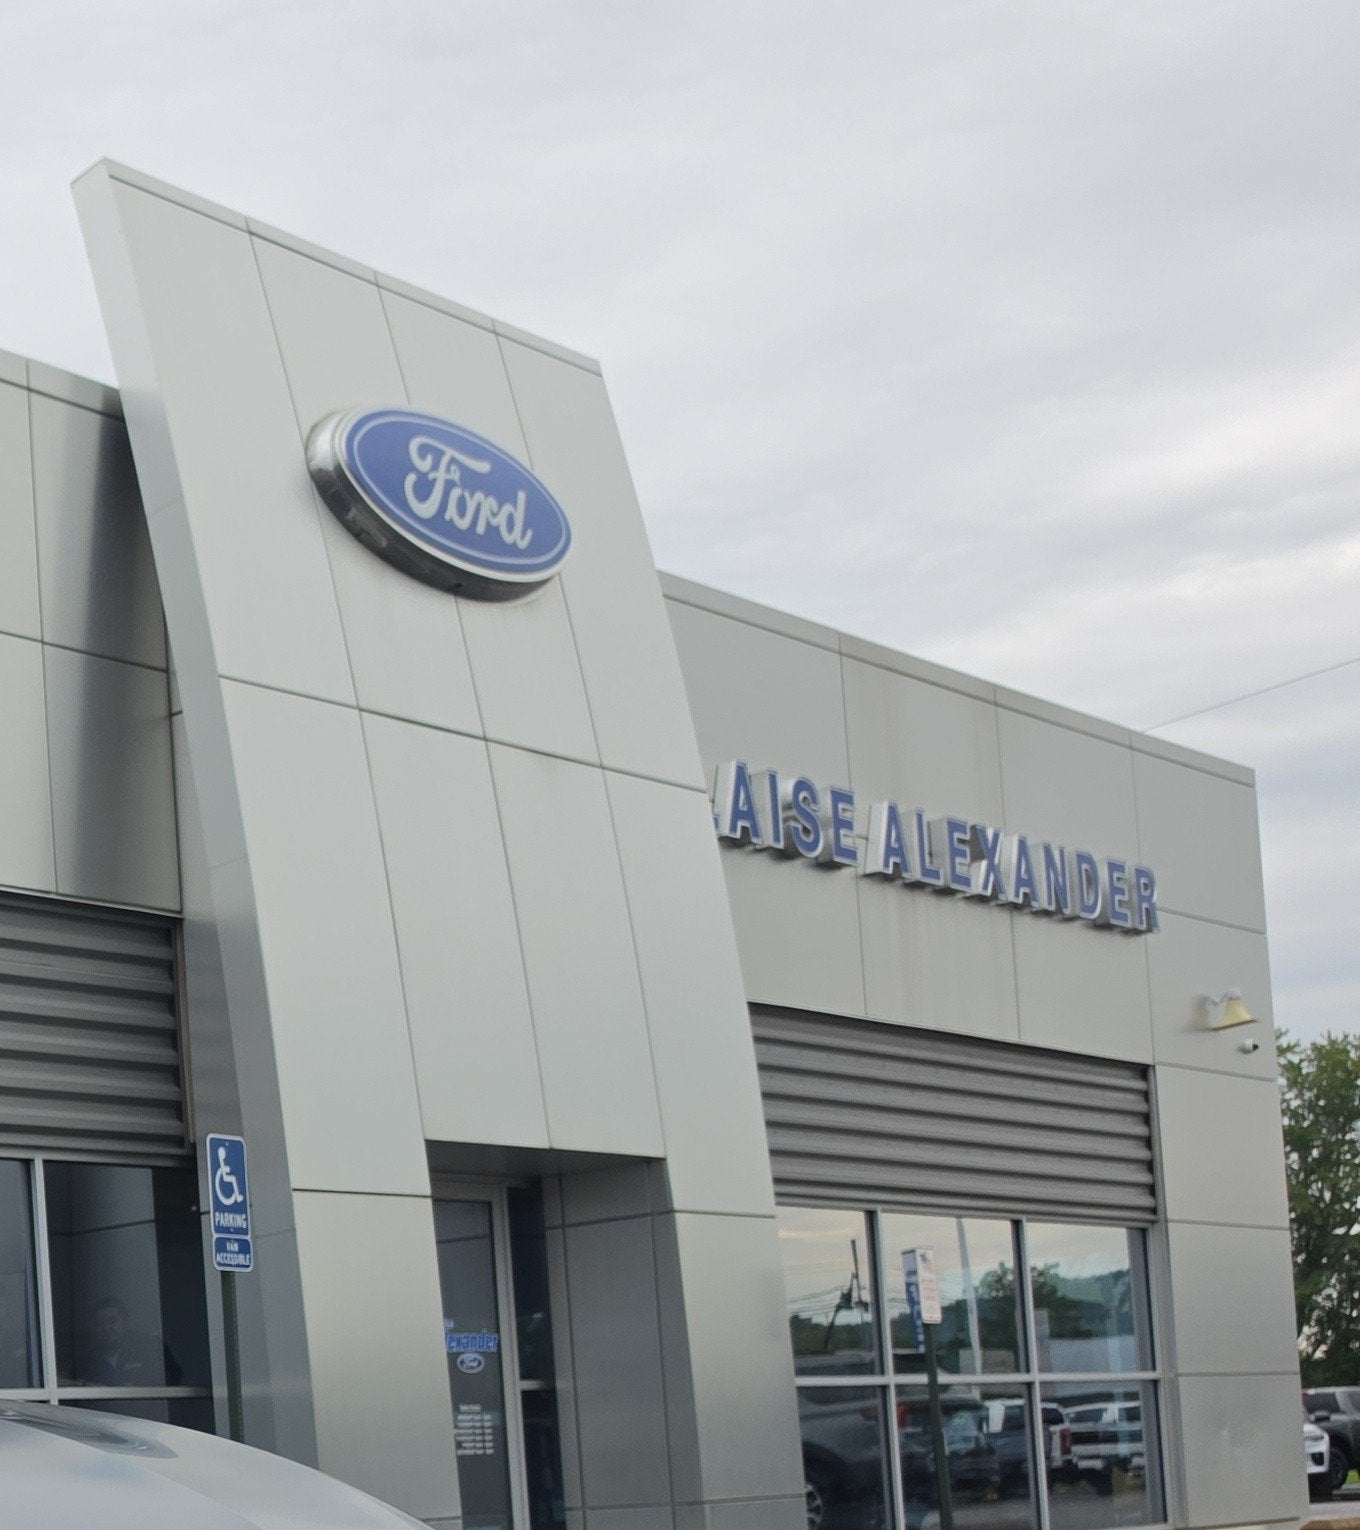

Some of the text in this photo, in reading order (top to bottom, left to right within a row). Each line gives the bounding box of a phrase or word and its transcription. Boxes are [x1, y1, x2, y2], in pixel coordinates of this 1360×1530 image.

[404, 435, 533, 550] Ford
[714, 760, 1161, 933] AISE ALEXANDER
[215, 1211, 247, 1229] PARKING
